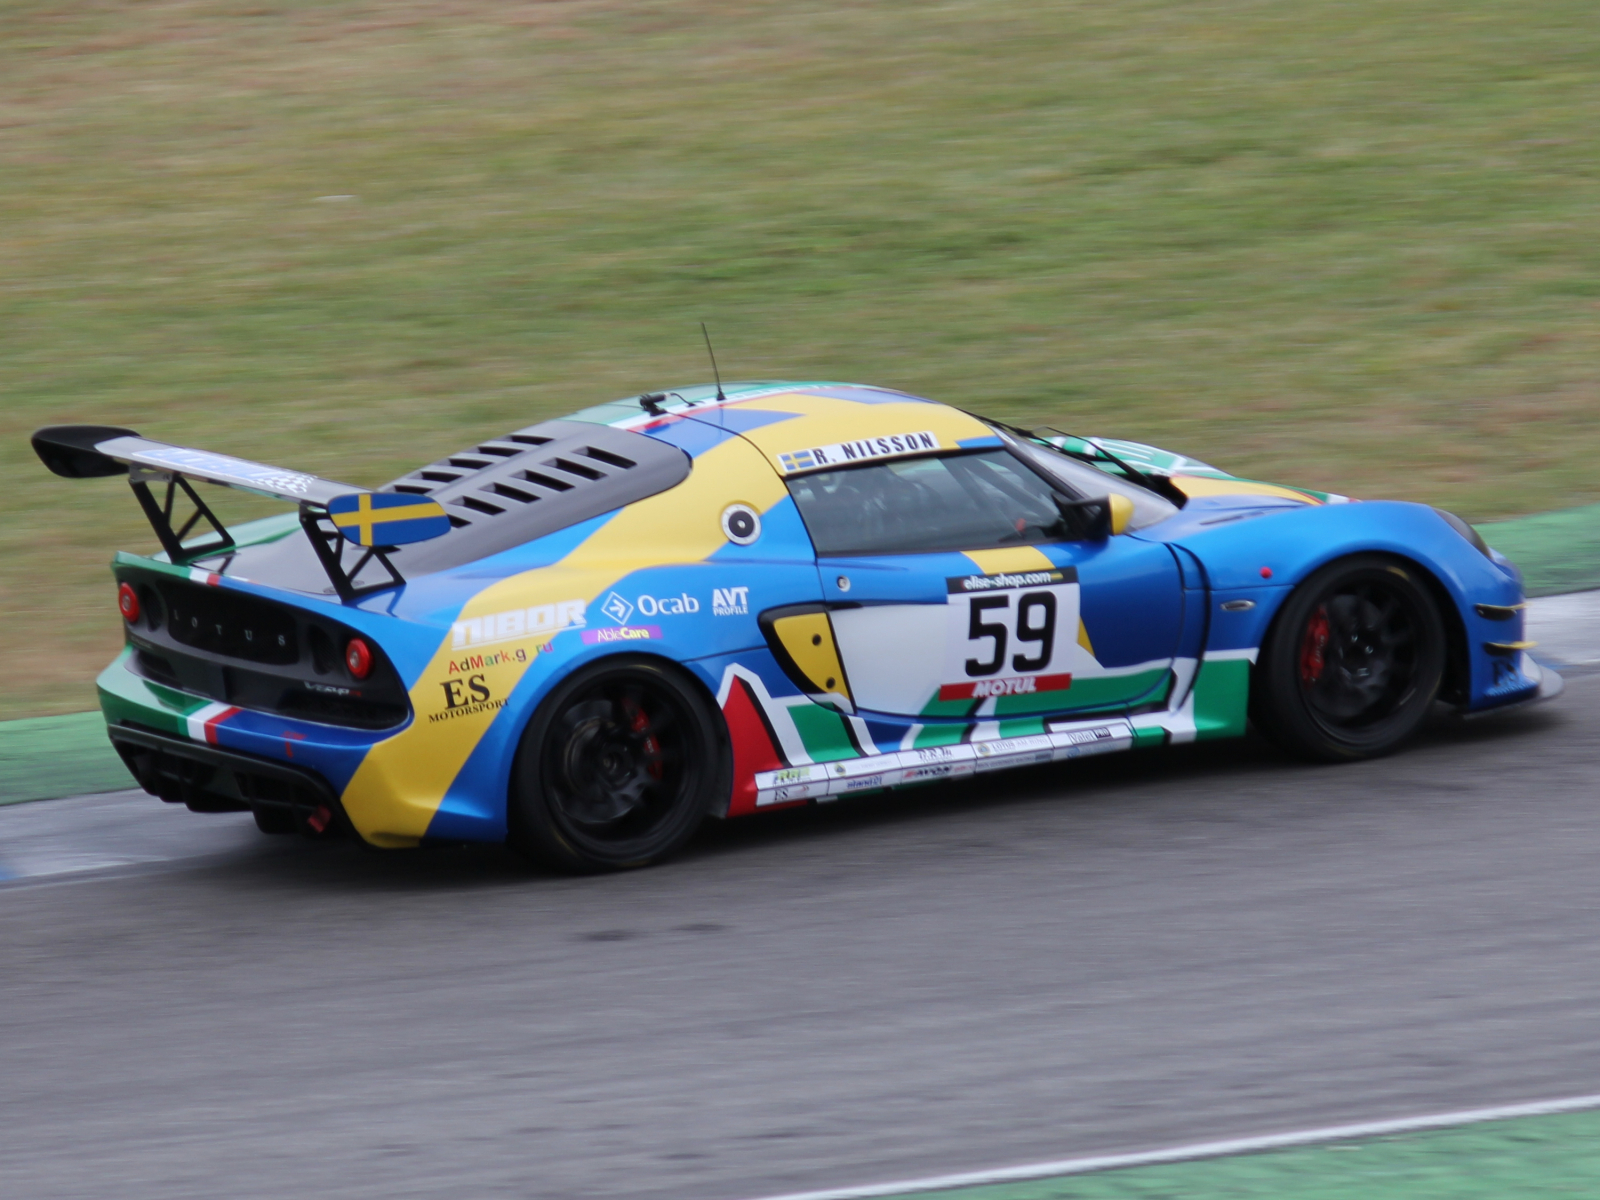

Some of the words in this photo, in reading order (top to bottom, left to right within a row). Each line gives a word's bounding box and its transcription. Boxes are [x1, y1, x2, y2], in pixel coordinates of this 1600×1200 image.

[811, 448, 837, 464] R.
[841, 432, 935, 459] NILSSON
[963, 572, 1052, 589] elise-shop.com
[637, 592, 700, 616] Ocab
[713, 586, 749, 607] AVT
[713, 604, 749, 617] PROFILE
[173, 609, 286, 647] LOTUS
[452, 598, 588, 648] NIBOR
[965, 590, 1058, 677] 59
[439, 673, 491, 711] ES
[971, 675, 1037, 698] MOTUL
[428, 697, 511, 725] MOTORSPORT
